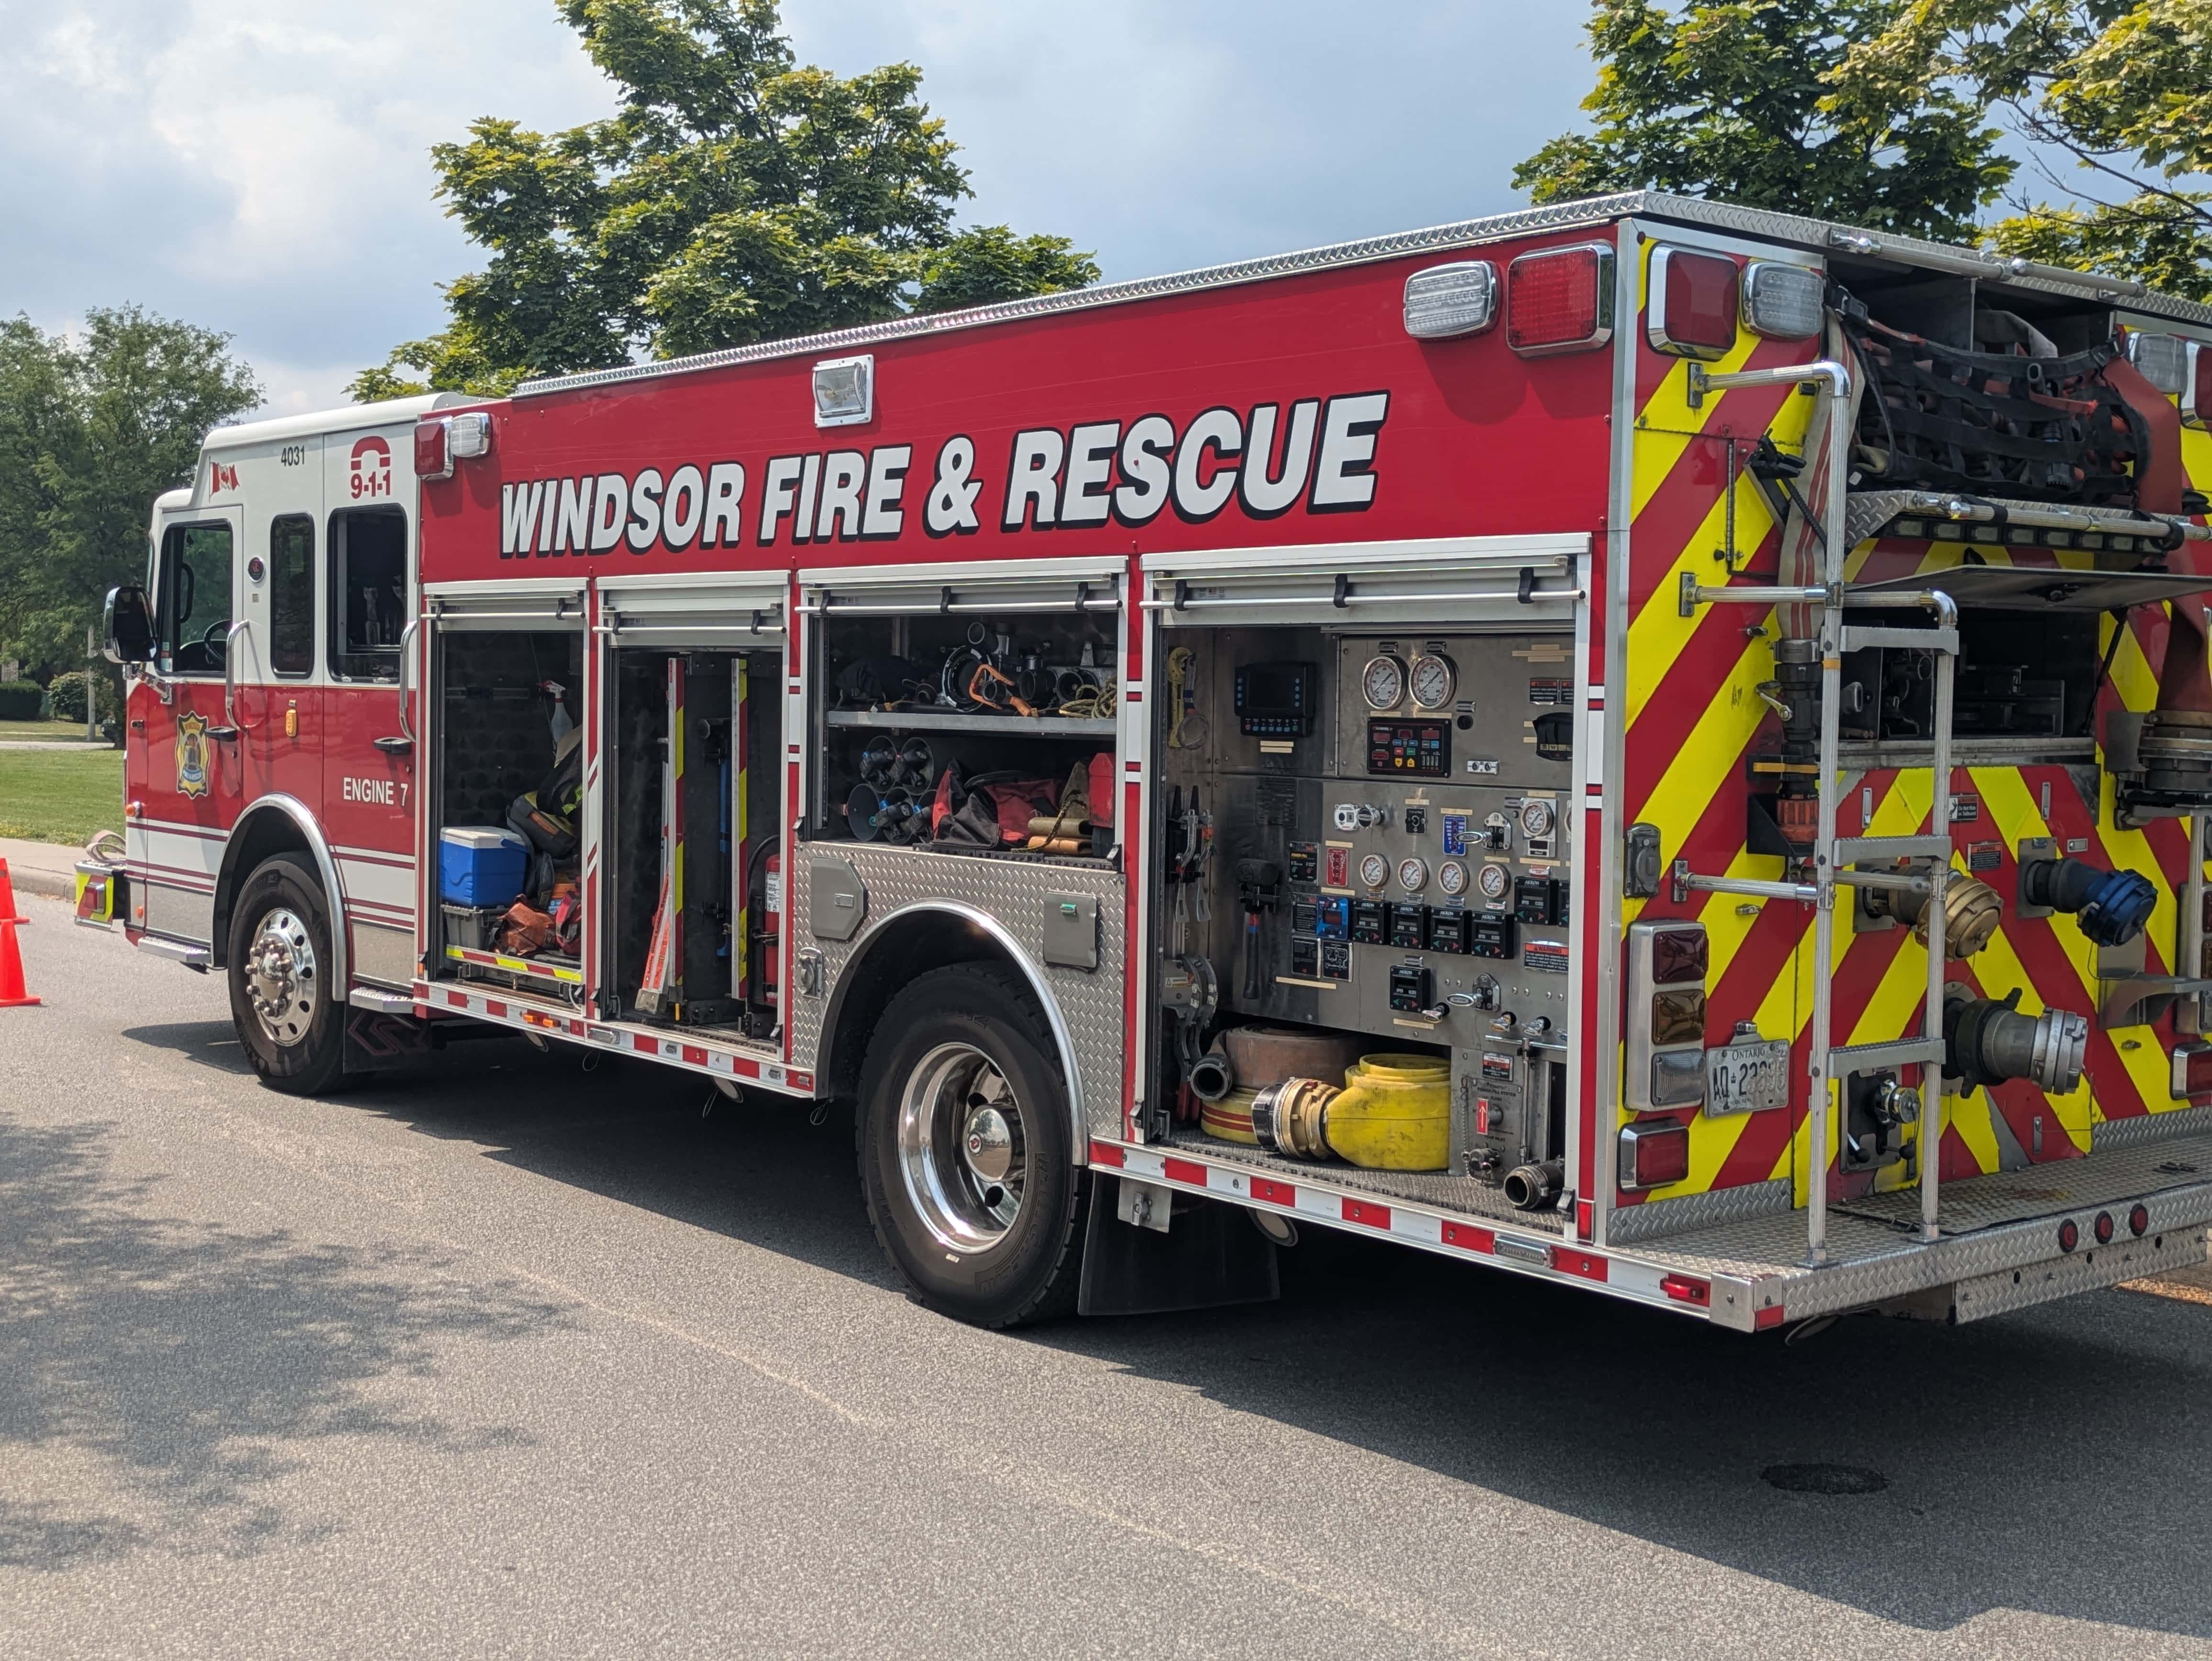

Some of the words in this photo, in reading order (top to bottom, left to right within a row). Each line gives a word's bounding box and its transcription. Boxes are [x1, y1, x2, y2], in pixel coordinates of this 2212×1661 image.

[281, 445, 304, 467] 4031
[351, 470, 390, 499] 9-1-1
[502, 461, 745, 556] WINDSOR
[760, 444, 912, 545] FIRE
[925, 434, 983, 537] &
[1002, 389, 1390, 531] RESCUE
[343, 777, 394, 805] ENGINE
[400, 783, 408, 806] 7
[1732, 1046, 1765, 1061] ONTARIO
